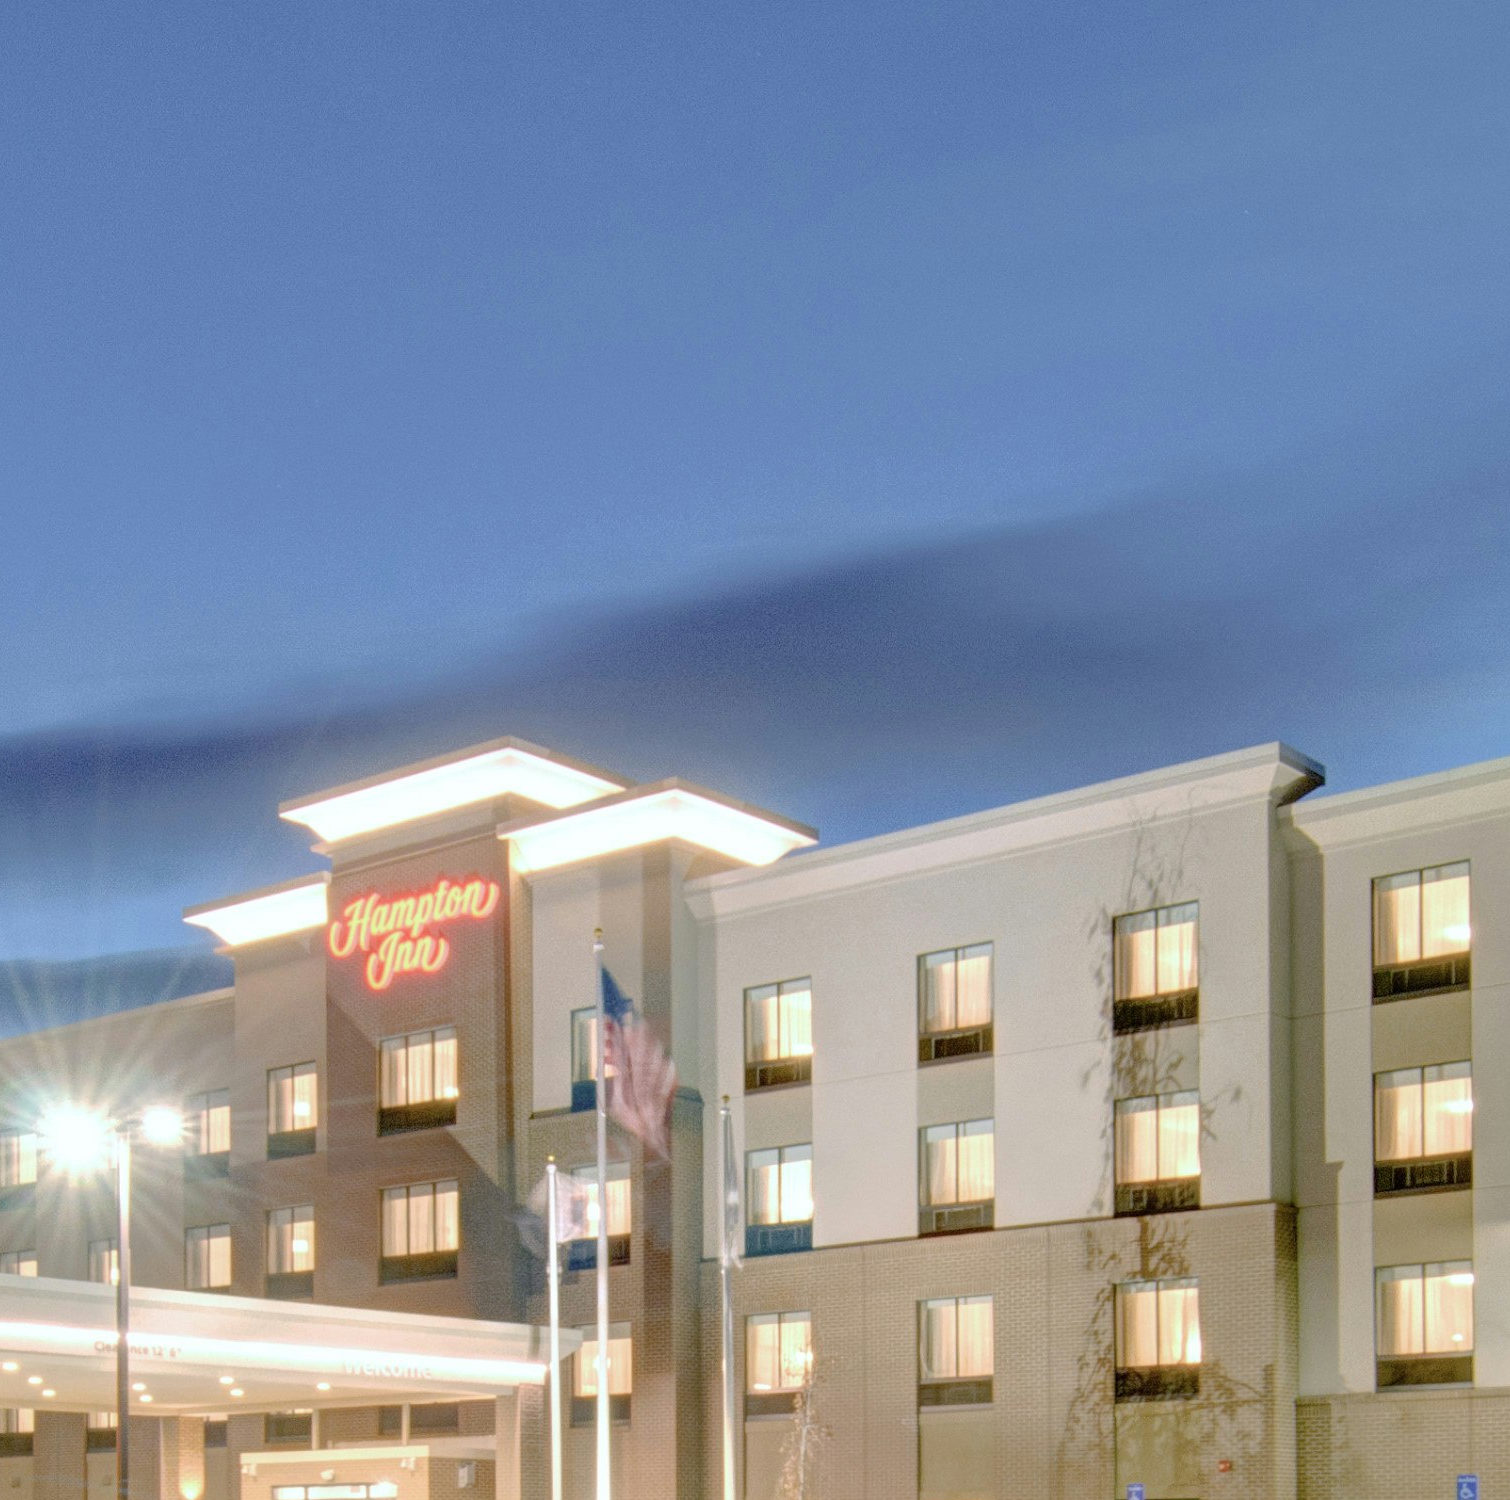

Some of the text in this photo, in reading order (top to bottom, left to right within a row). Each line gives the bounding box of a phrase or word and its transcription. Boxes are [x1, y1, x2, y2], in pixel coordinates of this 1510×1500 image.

[329, 879, 499, 957] Hampton
[367, 930, 449, 989] Inn
[94, 1341, 149, 1355] Cleance
